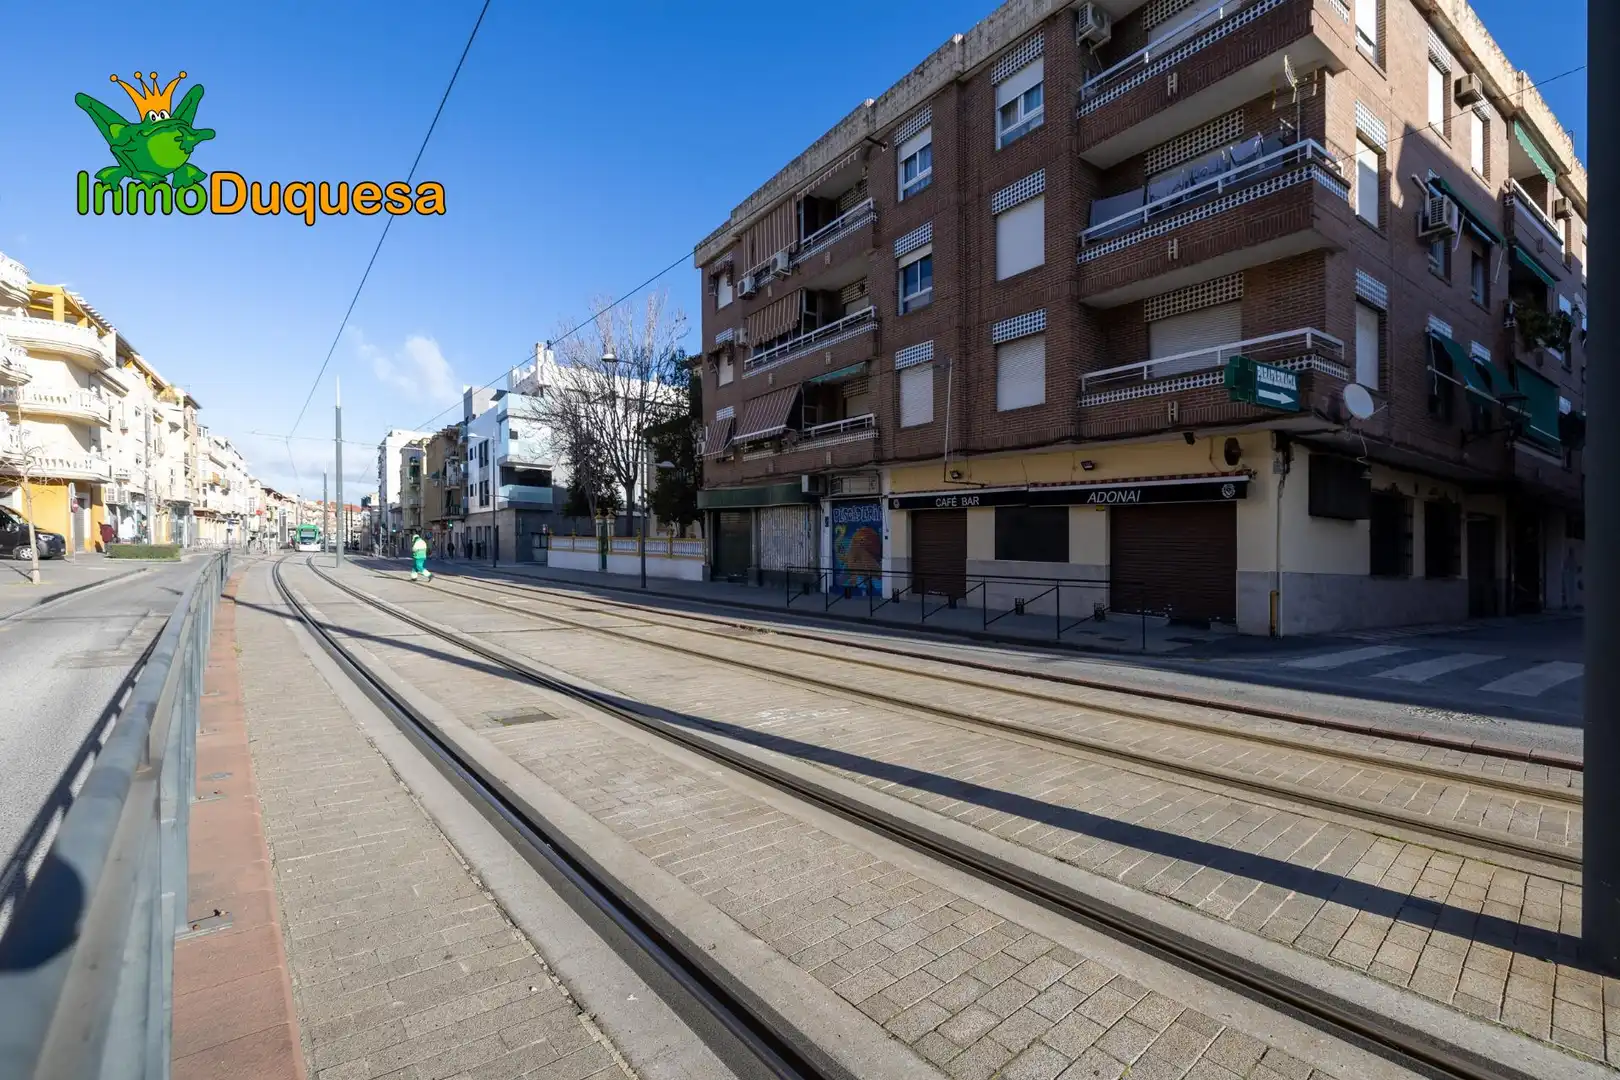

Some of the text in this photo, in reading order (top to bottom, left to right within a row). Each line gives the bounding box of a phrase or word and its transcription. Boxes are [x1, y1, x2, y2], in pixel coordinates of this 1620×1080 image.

[935, 495, 980, 508] CAFÉ BAR
[1086, 489, 1143, 504] ADONAI
